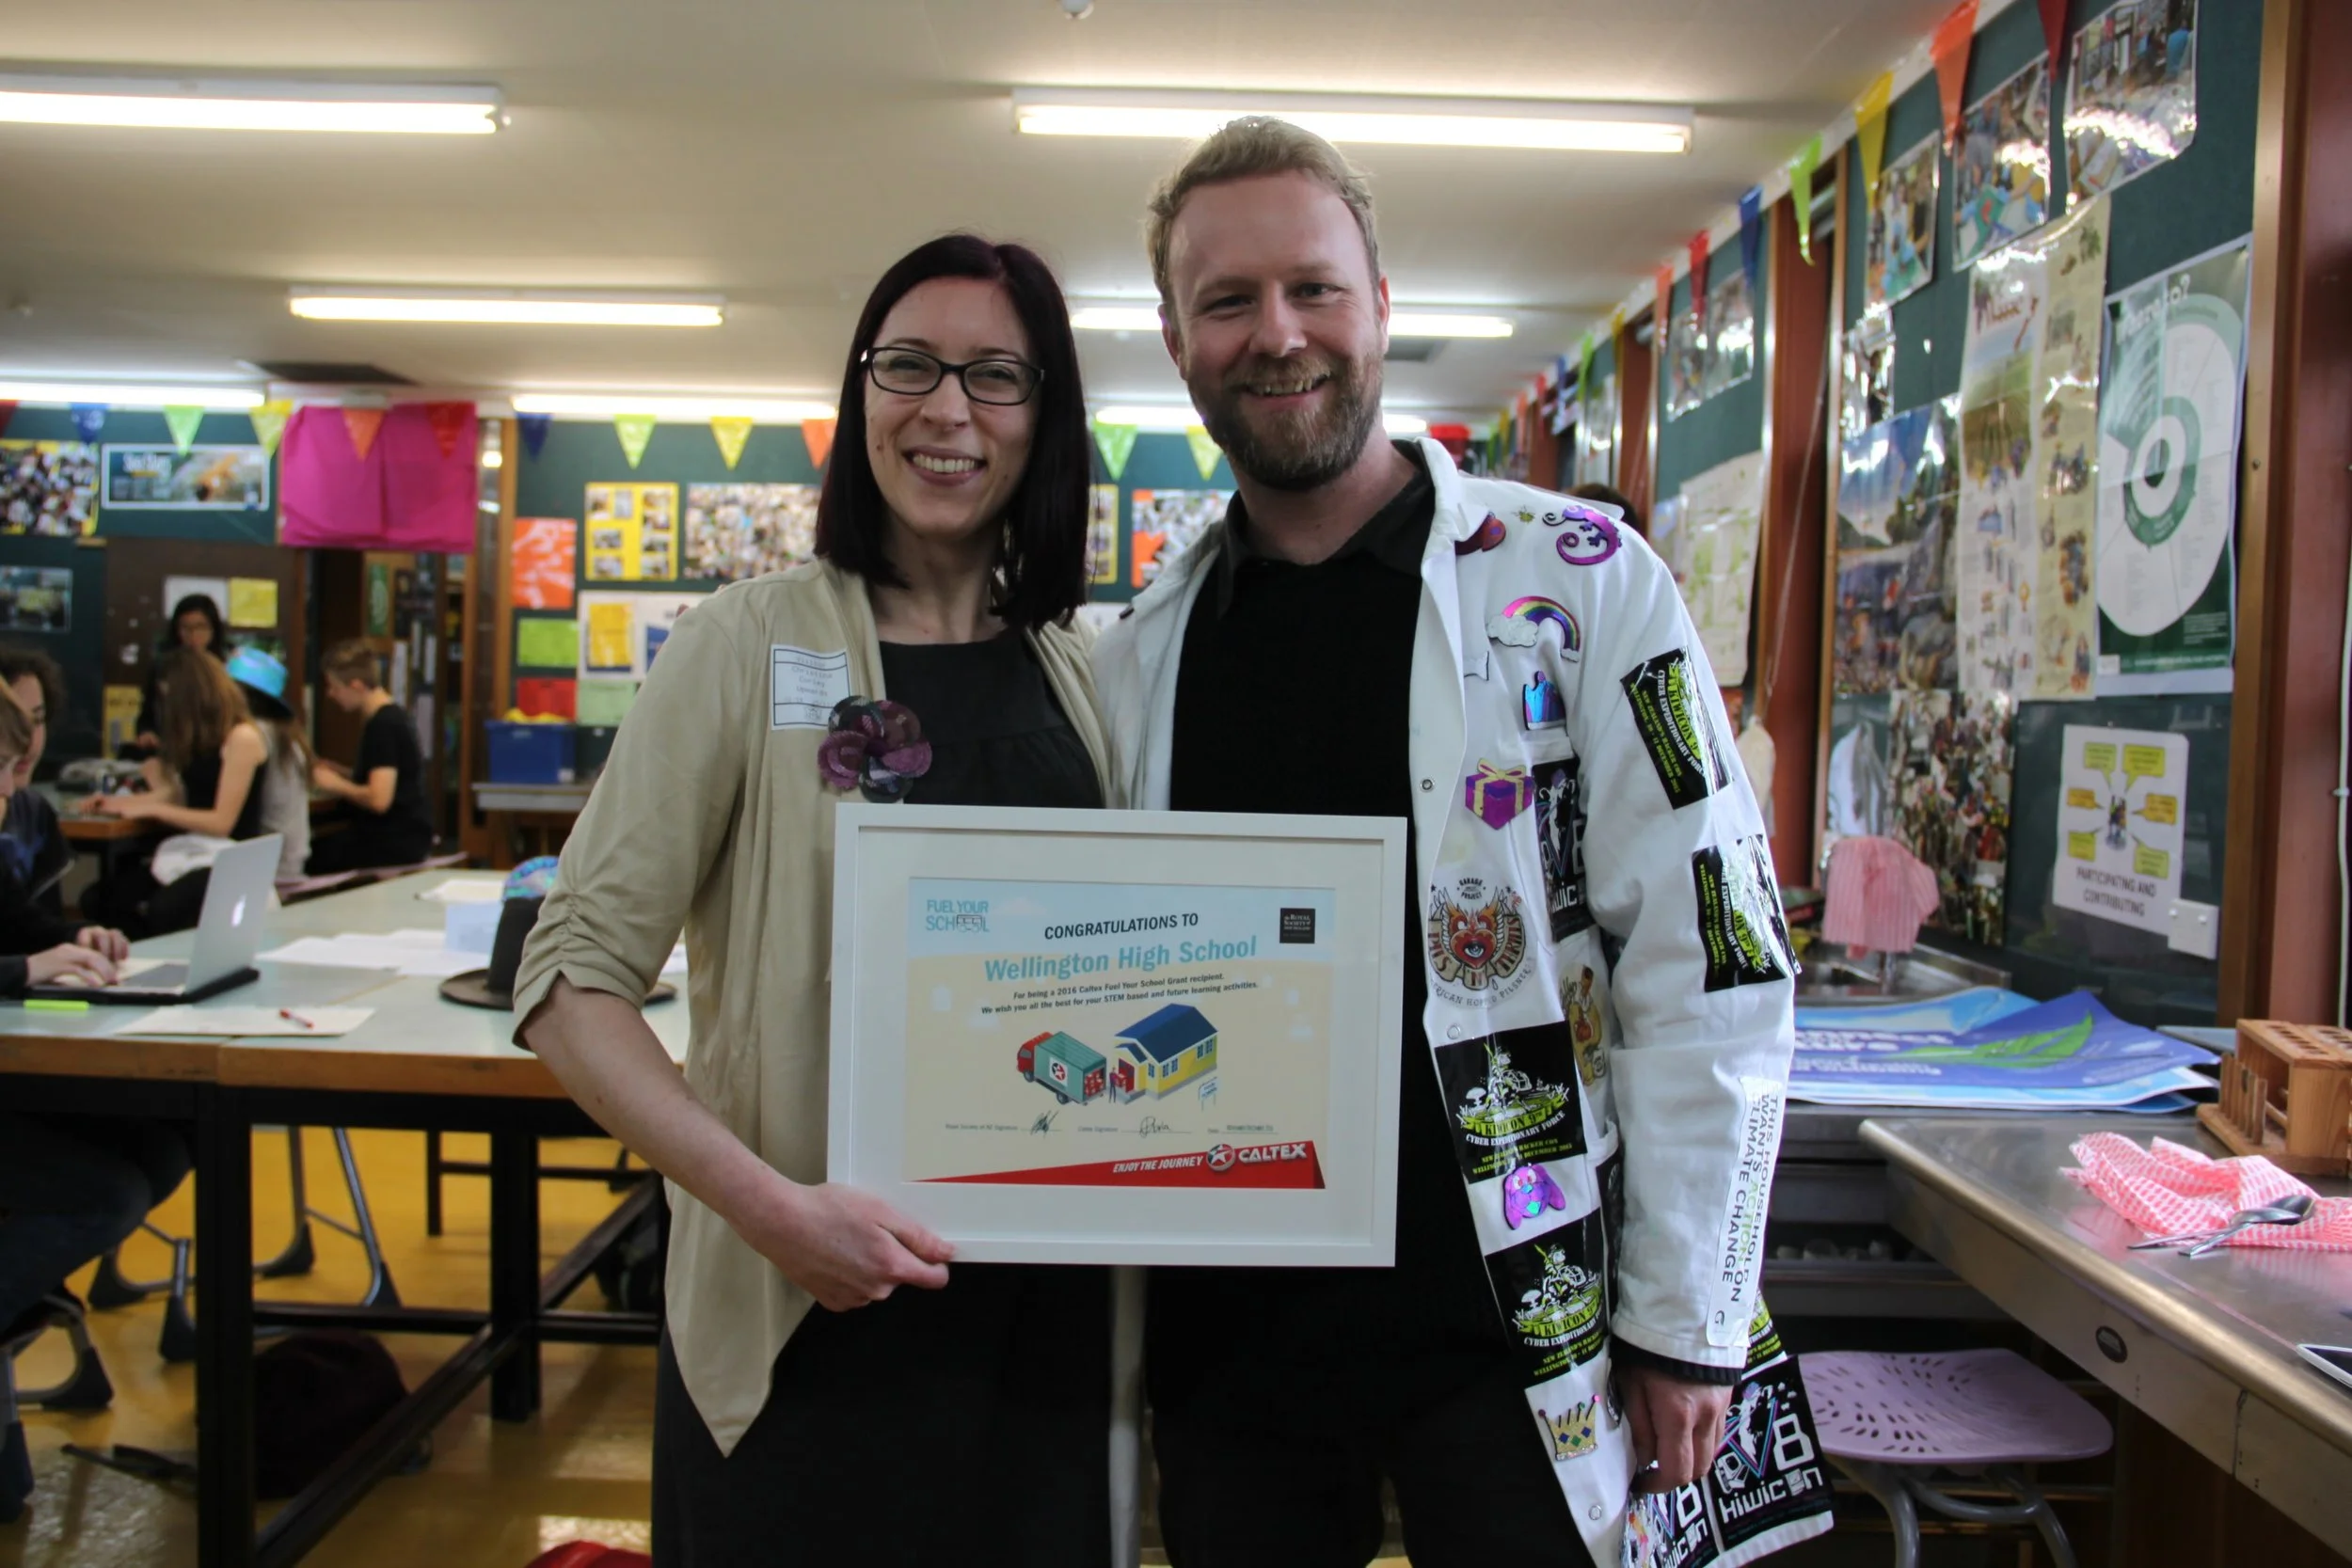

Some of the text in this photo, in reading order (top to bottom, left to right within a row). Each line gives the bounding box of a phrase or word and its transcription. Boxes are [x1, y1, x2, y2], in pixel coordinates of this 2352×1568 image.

[1658, 669, 1666, 697] CYBER
[1659, 695, 1691, 757] EXPEDITIONARY
[2076, 865, 2157, 897] PARTICIPATING AND
[927, 899, 989, 913] FUEL YOUR
[1460, 892, 1483, 900] PROJECT
[2084, 887, 2145, 917] CONTRIBUTING
[1044, 912, 1199, 940] CONGRATULATIONS TO
[985, 935, 1257, 981] Wellington High School
[995, 1005, 1011, 1013] wish
[1014, 1005, 1027, 1013] you
[1029, 1002, 1039, 1010] all
[1041, 1001, 1053, 1009] the
[1055, 999, 1071, 1007] best
[1073, 997, 1084, 1006] for
[1086, 997, 1102, 1006] your
[1104, 993, 1124, 1003] STEM
[1127, 991, 1149, 1001] based
[1151, 990, 1165, 999] and
[1167, 988, 1189, 997] future
[1191, 984, 1221, 994] learning
[1027, 990, 1048, 998] being
[1057, 986, 1077, 995] 2016
[1079, 985, 1103, 993] Caltex
[1104, 982, 1120, 990] Fuel
[1122, 981, 1137, 990] Your
[1140, 978, 1165, 988] School
[1168, 976, 1187, 985] Grant
[1466, 1111, 1565, 1147] CYBER EXPEDITIONARY FORCE
[1113, 1156, 1203, 1174] ENJOY THE JOURNEY
[1238, 1143, 1308, 1163] CALTEX
[1730, 1094, 1770, 1302] WANTS ACTION ON
[1743, 1095, 1779, 1282] THIS HOUSEHOLD
[1722, 1189, 1747, 1282] CHANGE
[1524, 1337, 1549, 1347] CYBER
